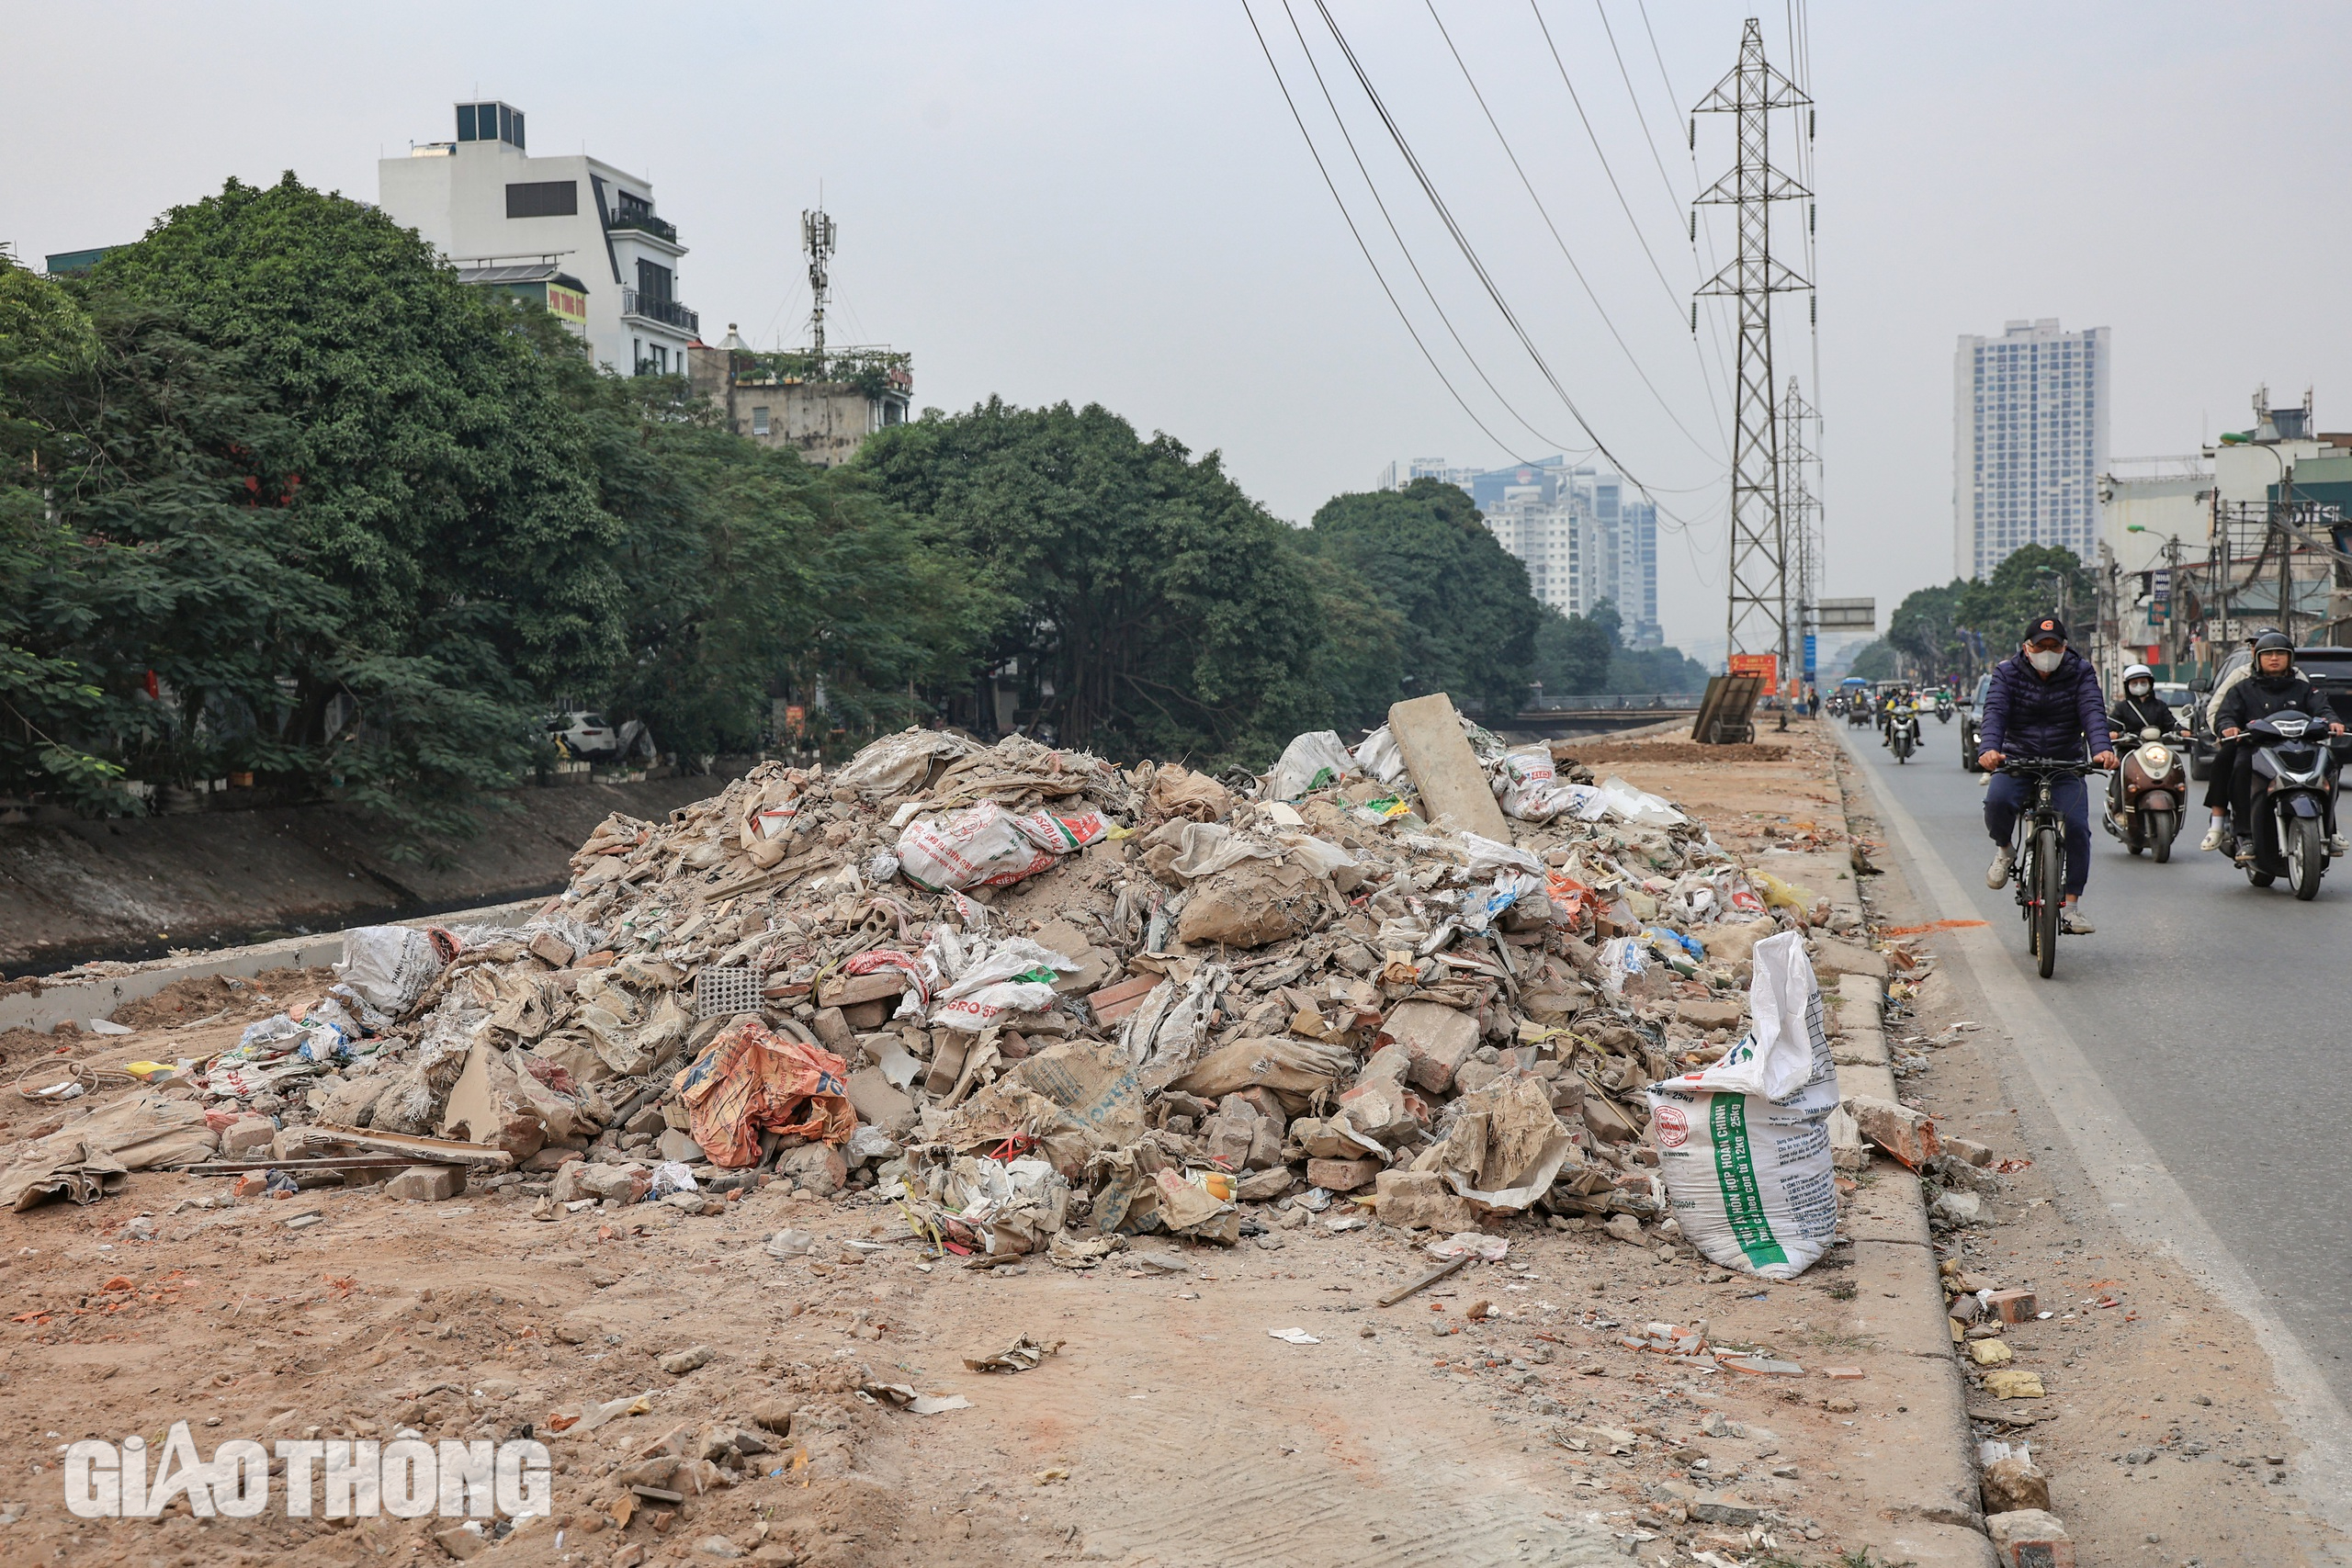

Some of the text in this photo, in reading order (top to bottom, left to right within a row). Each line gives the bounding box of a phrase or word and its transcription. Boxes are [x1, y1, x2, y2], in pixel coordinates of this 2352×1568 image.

[1672, 1091, 1694, 1103] 25kg
[1711, 1104, 1728, 1138] CHỈNH
[1730, 1104, 1741, 1128] 25kg
[1718, 1140, 1733, 1168] HOÀN
[1735, 1136, 1746, 1160] 12kg
[1736, 1163, 1749, 1174] từ
[1742, 1176, 1754, 1192] con
